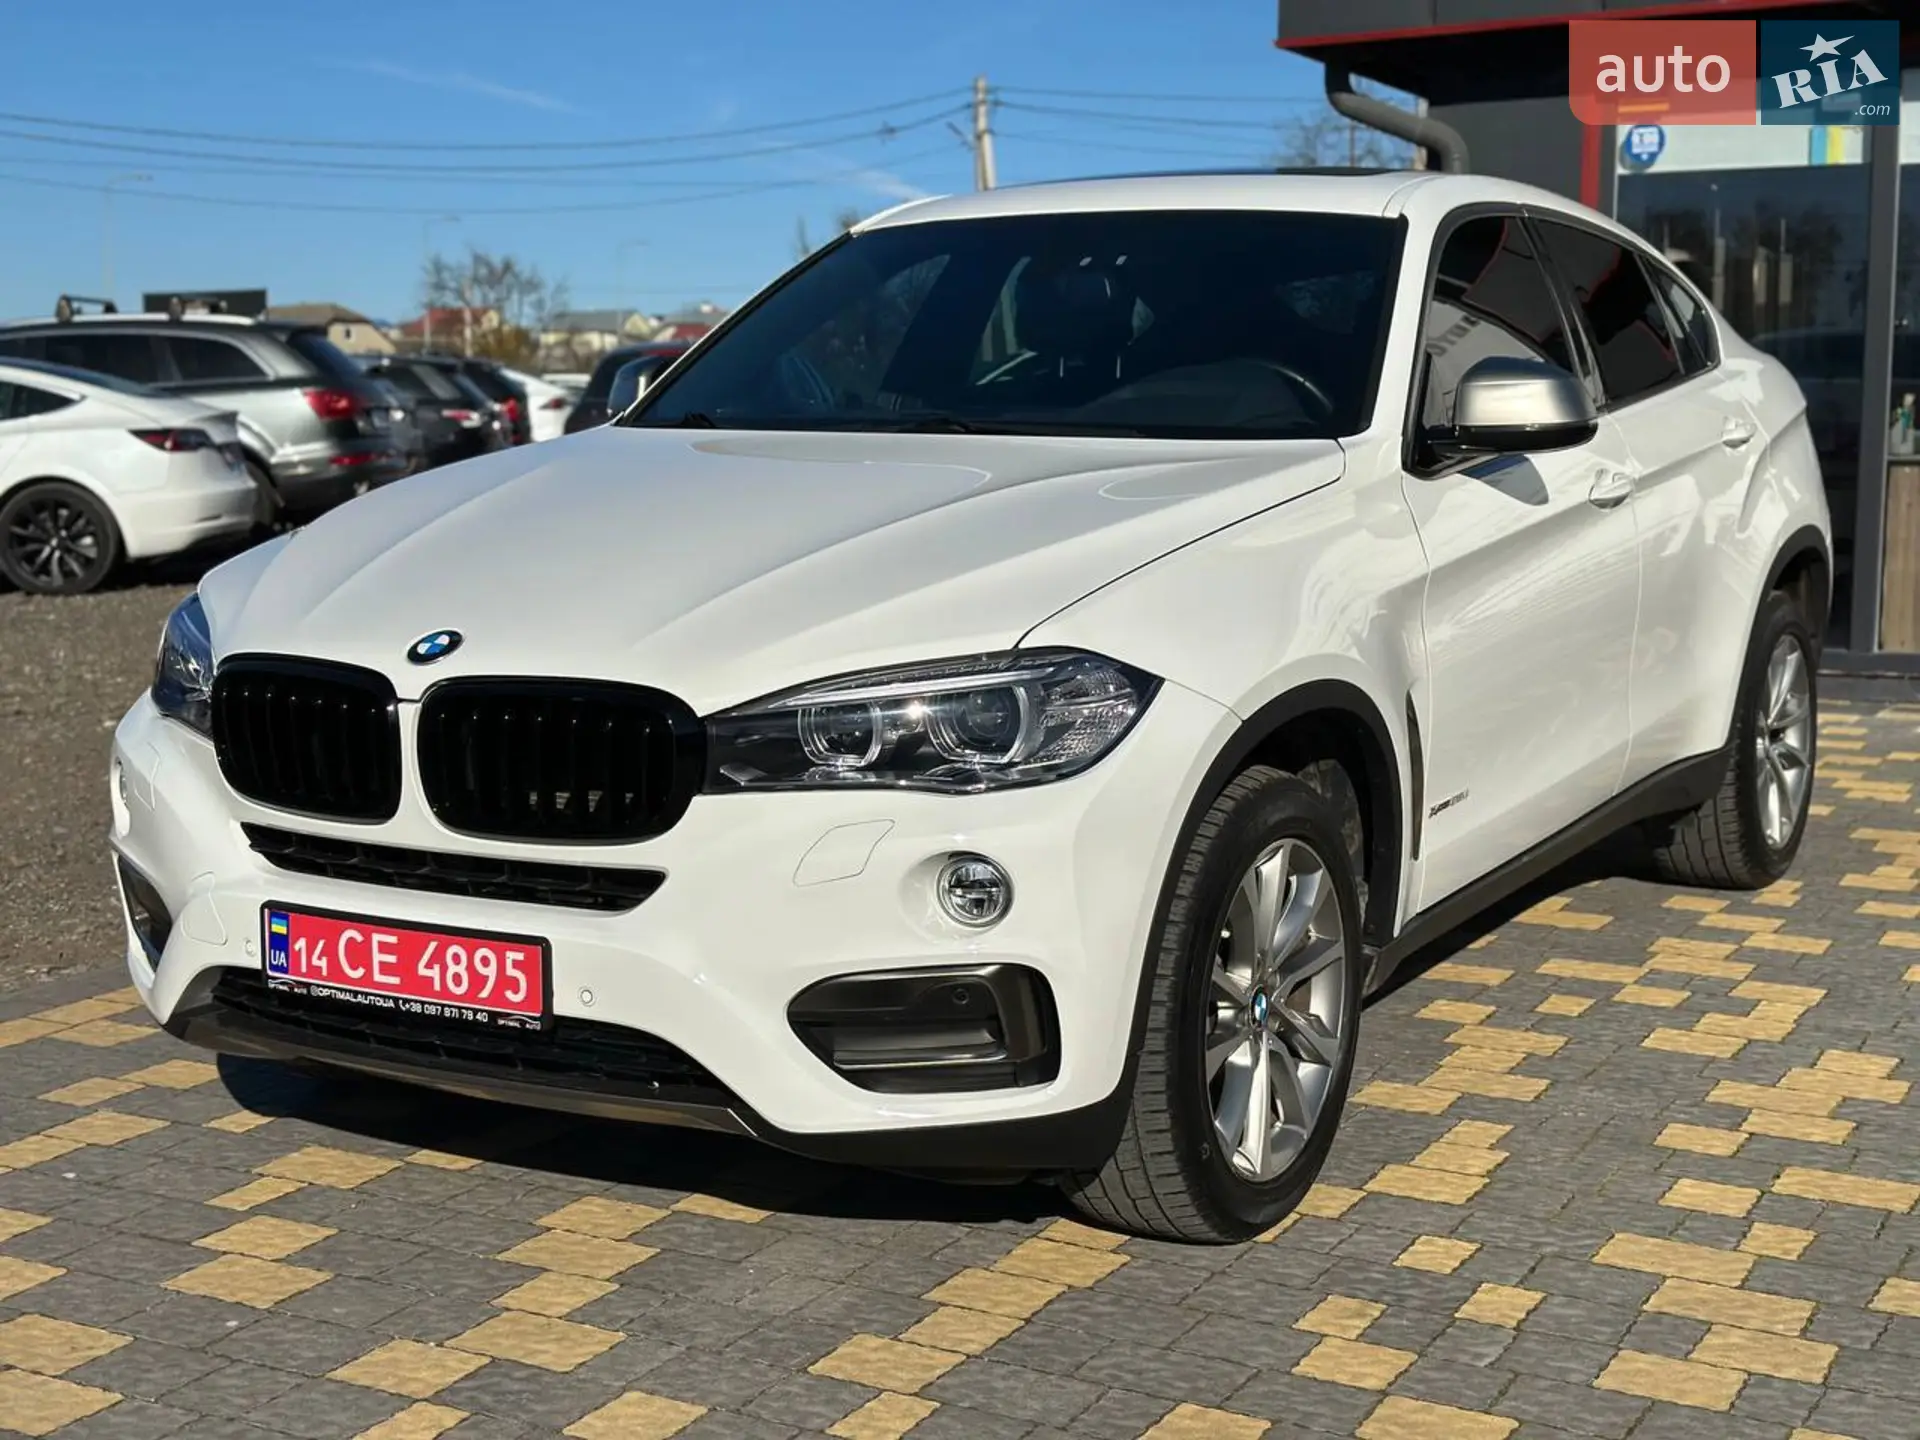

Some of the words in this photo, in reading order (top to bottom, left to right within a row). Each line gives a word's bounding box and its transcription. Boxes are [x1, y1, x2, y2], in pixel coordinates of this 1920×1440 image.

[271, 951, 287, 968] UA
[294, 937, 327, 976] 14
[338, 929, 400, 984] CE
[417, 941, 528, 1003] 4895
[476, 1012, 488, 1022] 40
